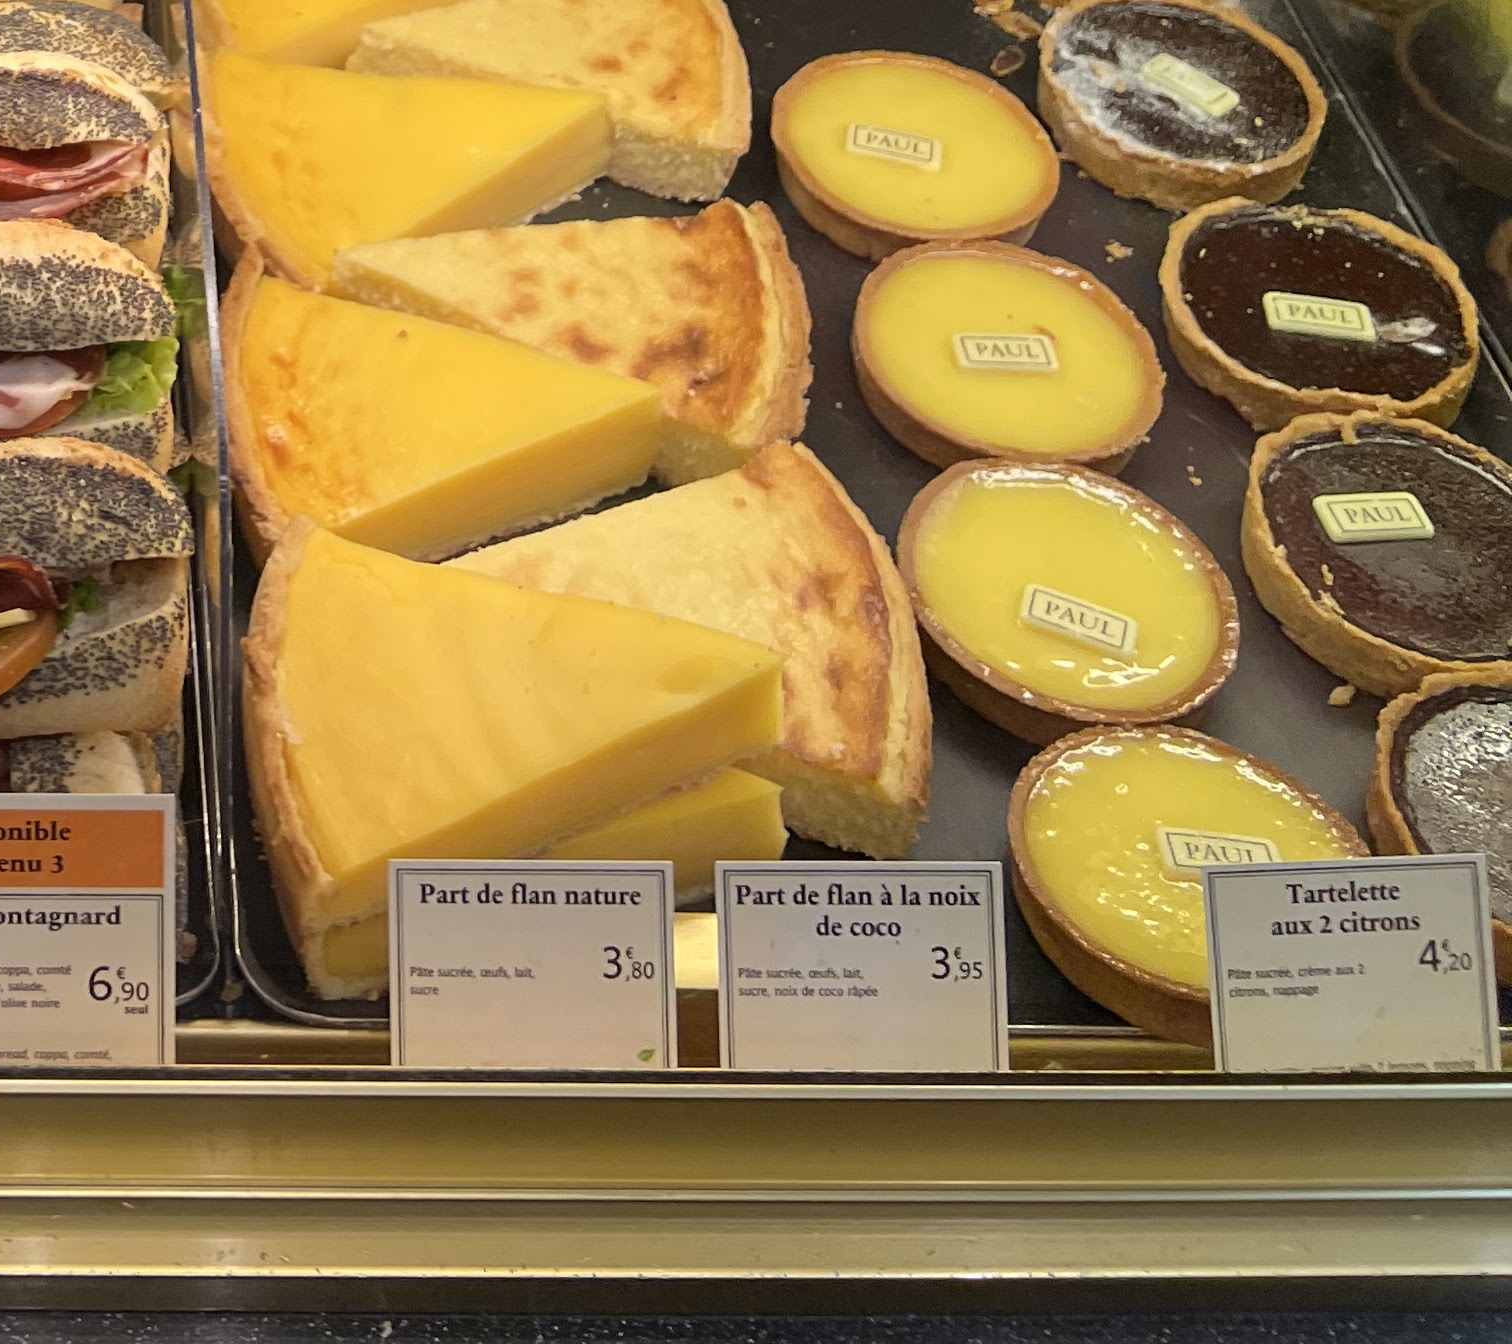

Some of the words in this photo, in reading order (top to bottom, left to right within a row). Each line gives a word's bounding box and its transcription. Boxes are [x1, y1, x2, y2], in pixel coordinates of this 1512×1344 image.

[867, 132, 925, 155] PAUL
[1287, 303, 1354, 324] PAUL
[975, 342, 1040, 359] PAUL
[1344, 506, 1411, 523] PAUL
[1045, 601, 1115, 637] PAUL
[51, 855, 64, 873] 3
[420, 884, 470, 904] Part
[477, 883, 503, 904] de
[511, 883, 556, 904] flan
[565, 888, 641, 905] nature
[736, 885, 785, 905] Part
[793, 884, 819, 905] de
[828, 883, 873, 905] flan
[881, 884, 893, 905] à
[901, 884, 921, 905] la
[929, 885, 981, 906] noix
[1286, 881, 1400, 904] Tartelette
[816, 915, 842, 936] de
[850, 922, 901, 936] coco
[1272, 920, 1313, 935] aux
[1320, 915, 1332, 933] 2
[1340, 911, 1420, 933] citrons
